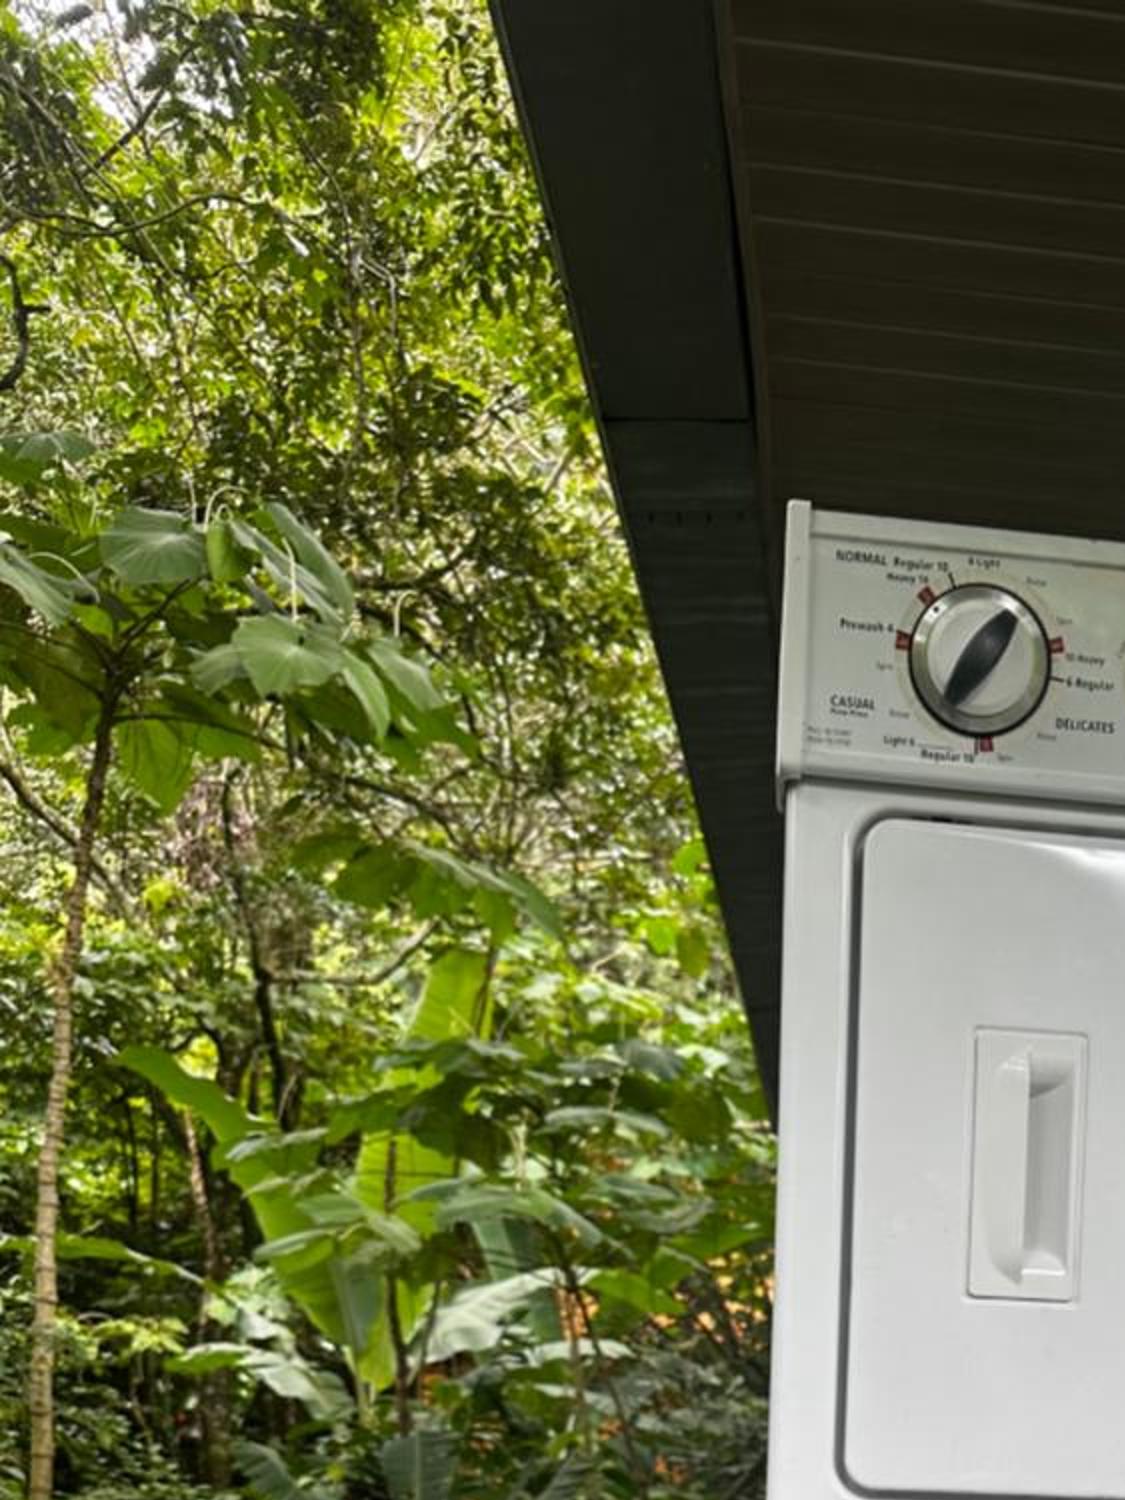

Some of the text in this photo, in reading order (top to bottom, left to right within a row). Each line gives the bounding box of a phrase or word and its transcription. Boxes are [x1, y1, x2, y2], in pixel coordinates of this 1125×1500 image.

[836, 549, 886, 566] NORMAL
[894, 556, 933, 571] Regular
[977, 558, 1000, 569] Light
[840, 617, 883, 631] Prewash
[1076, 677, 1114, 692] Regular
[830, 694, 875, 711] CASUAL
[1055, 717, 1116, 734] DELICATES
[883, 735, 907, 748] Light
[921, 749, 960, 762] Regular
